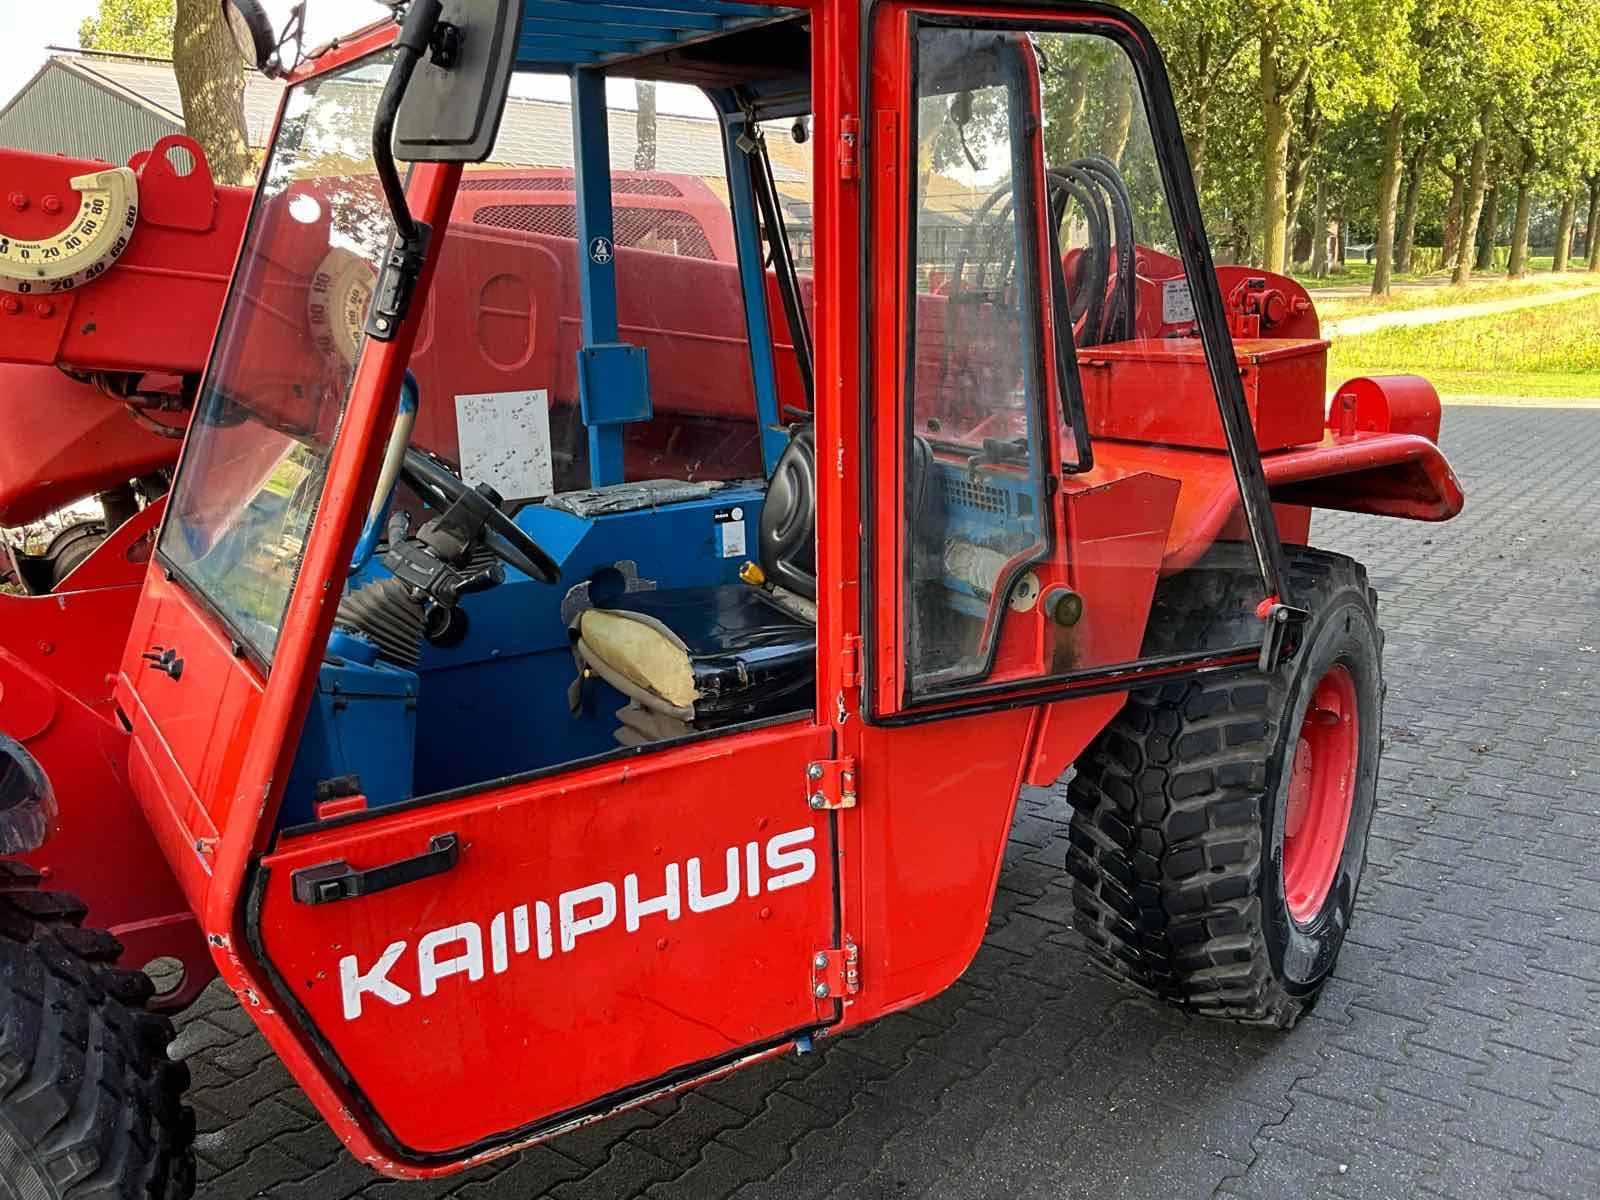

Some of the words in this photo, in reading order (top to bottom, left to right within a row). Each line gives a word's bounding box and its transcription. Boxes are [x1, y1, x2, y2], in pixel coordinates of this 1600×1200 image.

[41, 246, 60, 259] 20
[64, 236, 82, 251] 40
[81, 219, 97, 236] 60
[91, 198, 105, 215] 80
[50, 278, 74, 291] 20
[85, 262, 105, 279] 40
[110, 236, 126, 258] 60
[125, 205, 137, 228] 80
[339, 826, 816, 1021] KAMPHUIS
